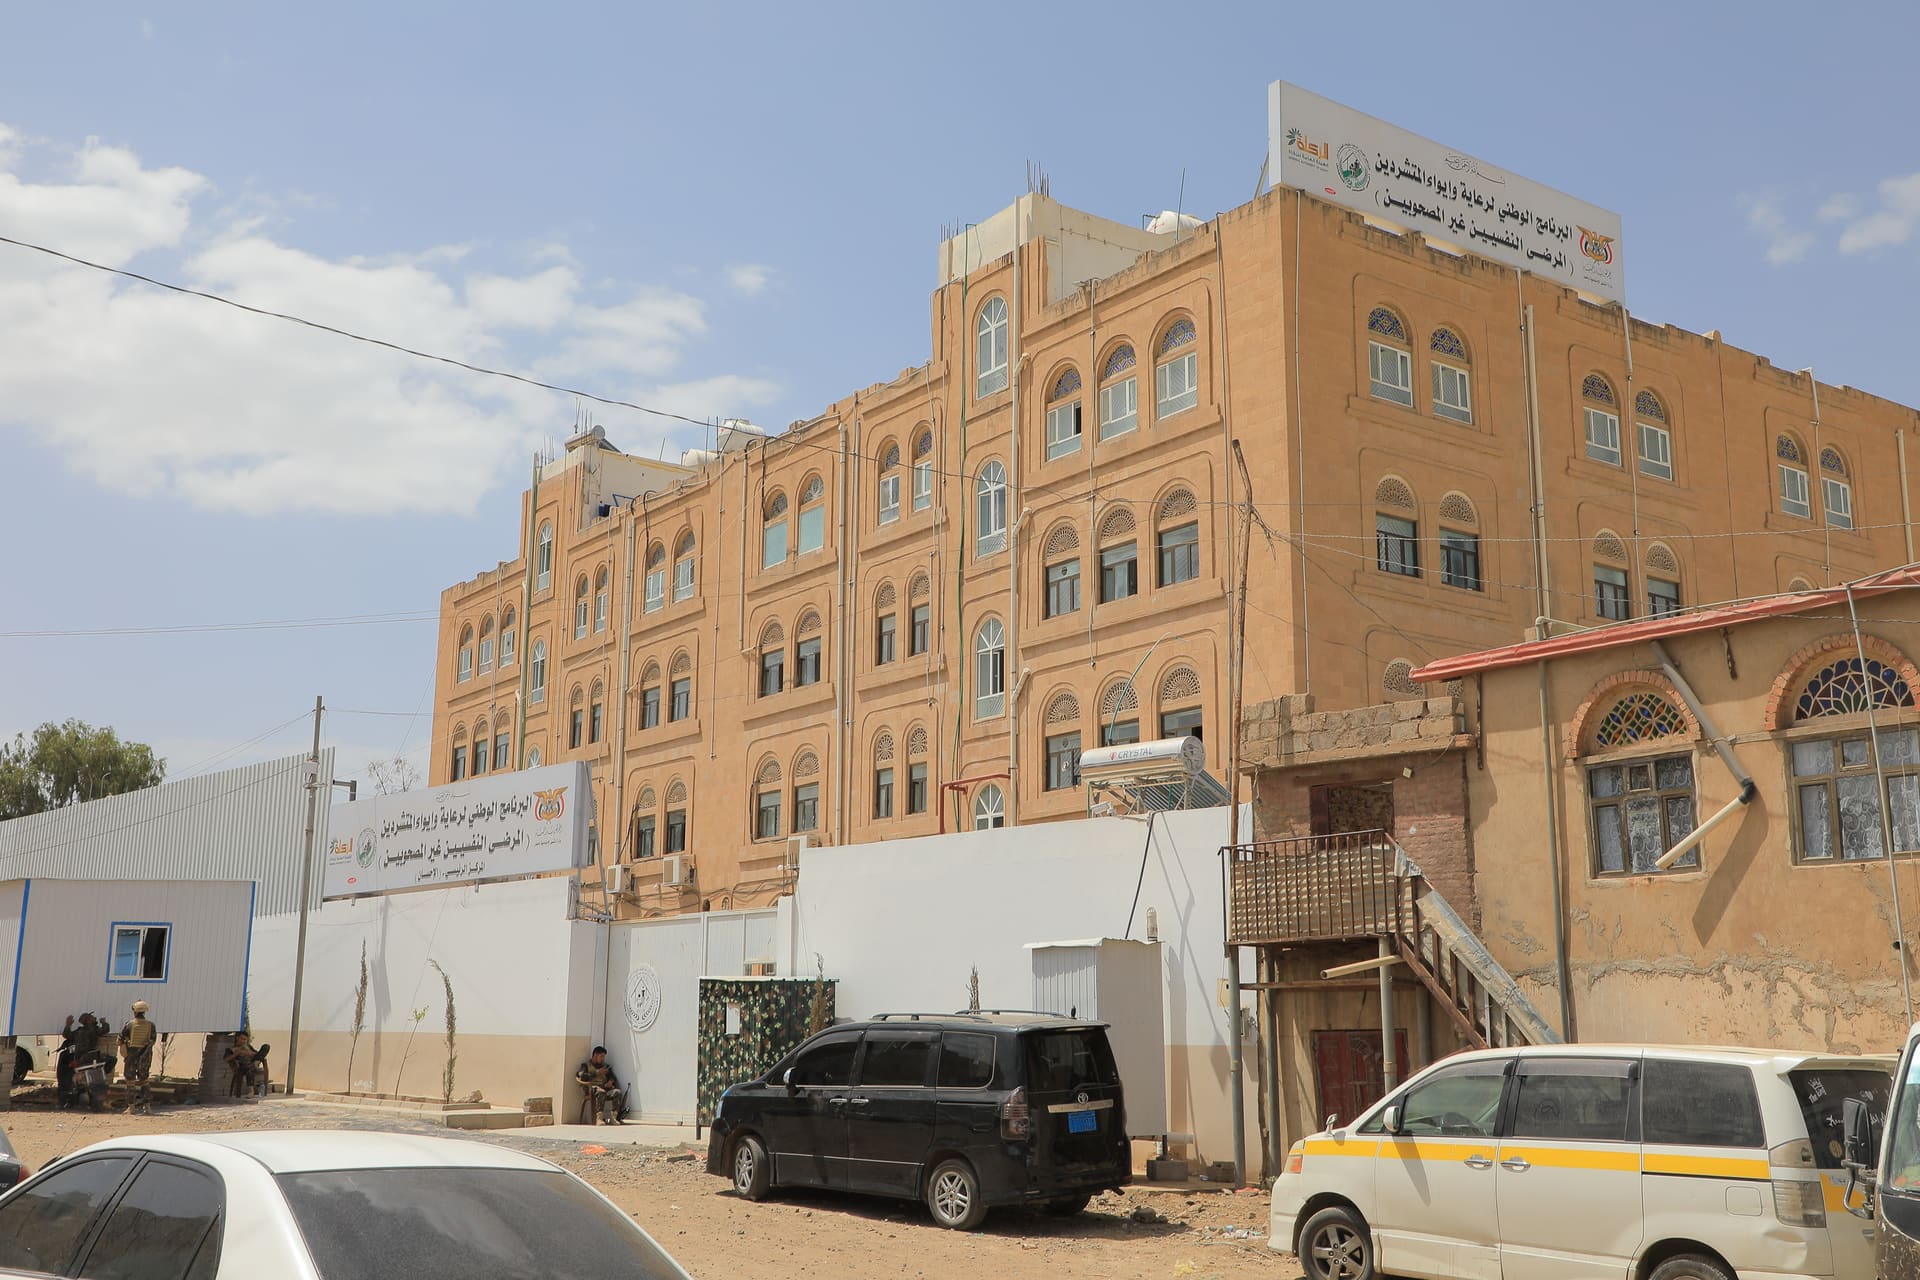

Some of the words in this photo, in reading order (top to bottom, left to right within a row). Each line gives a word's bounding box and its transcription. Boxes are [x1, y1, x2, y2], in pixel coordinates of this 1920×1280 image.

[1375, 153, 1426, 184] المتشردين
[1384, 188, 1444, 222] المصحوبين
[1461, 182, 1495, 212] لرعاية
[1448, 213, 1466, 234] غير
[1498, 202, 1533, 226] الوطني
[1470, 219, 1524, 251] النفسيين
[1536, 216, 1573, 243] البرنامج
[1527, 247, 1566, 269] المرضى
[1118, 748, 1152, 759] CRYSTAL
[440, 806, 466, 829] لرعاية
[468, 800, 498, 828] الوطني
[500, 794, 532, 820] البرنامج
[381, 810, 416, 838] المتشردين
[428, 839, 442, 862] غير
[444, 833, 486, 859] النفسيين
[488, 830, 524, 853] المرضى
[384, 843, 427, 868] المصحوبين
